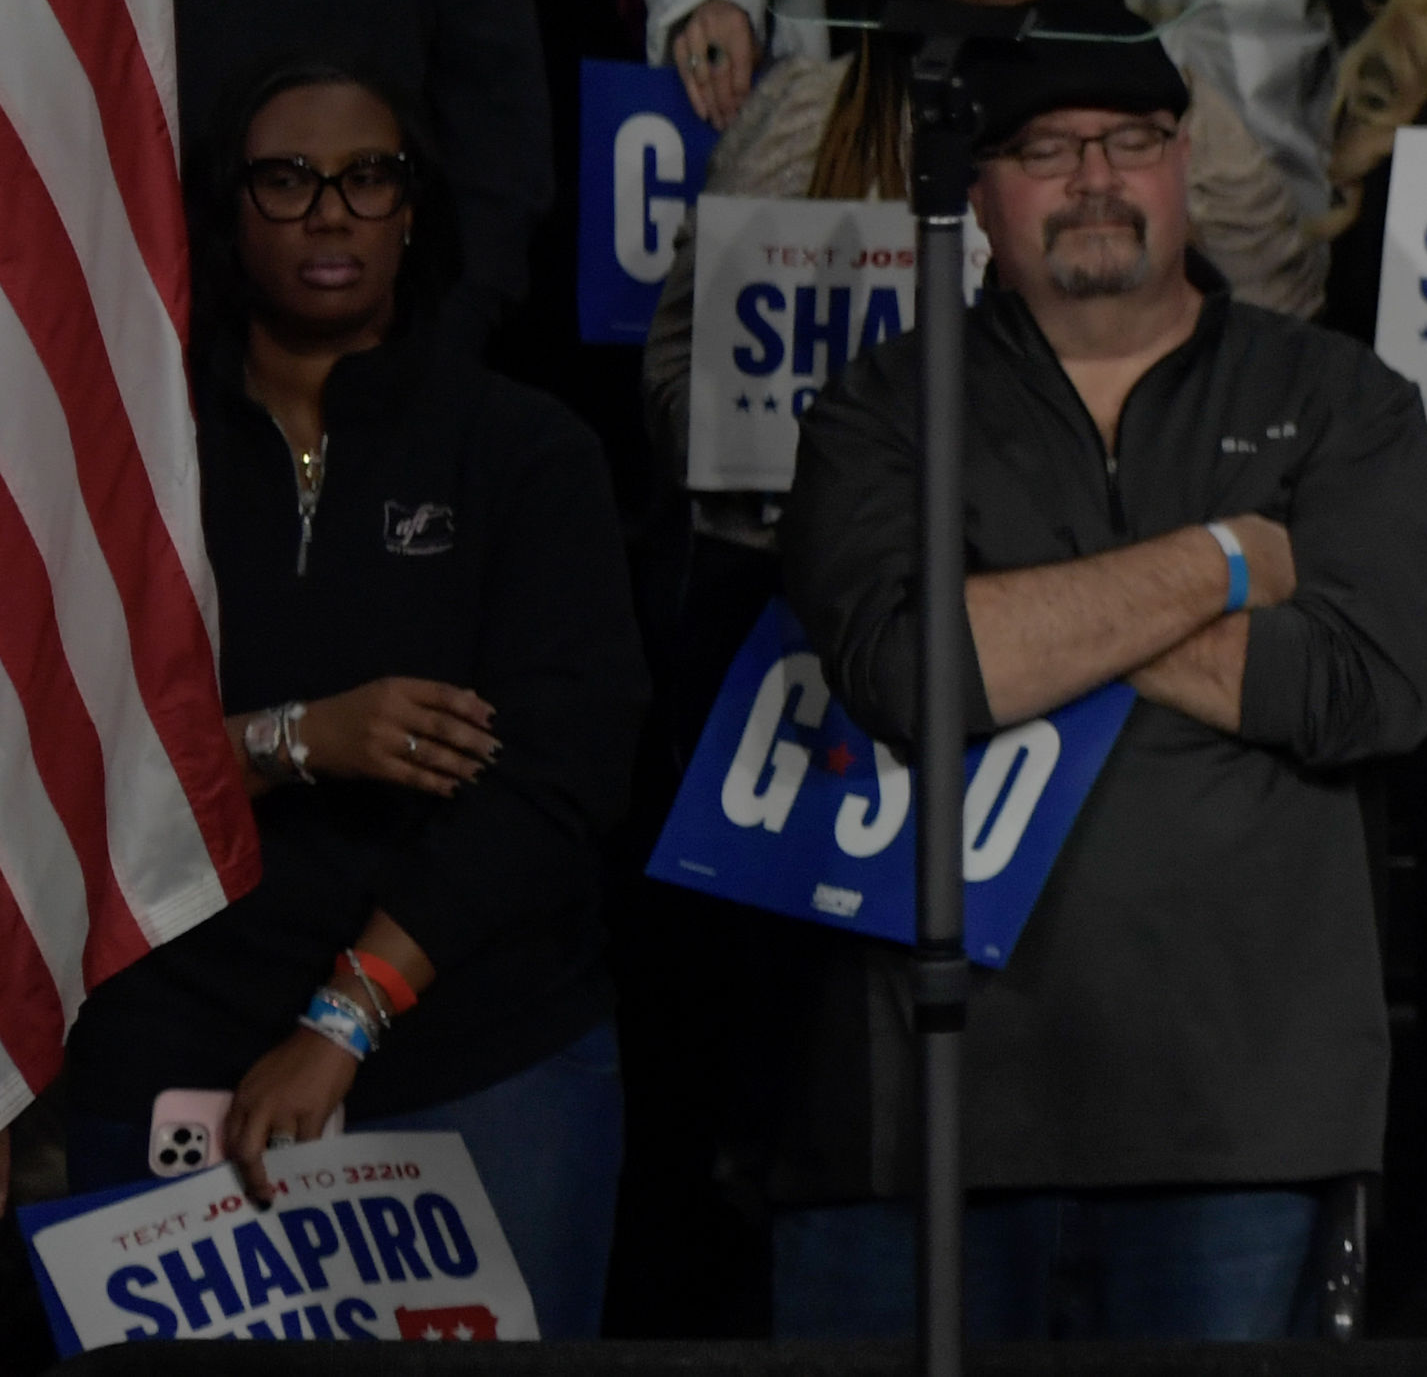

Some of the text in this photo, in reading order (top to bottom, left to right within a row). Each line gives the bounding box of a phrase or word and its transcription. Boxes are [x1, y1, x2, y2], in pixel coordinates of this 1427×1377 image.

[763, 246, 833, 269] TEXT
[850, 248, 914, 269] JOS
[113, 1163, 420, 1251] TEXT JOH TO 32210
[107, 1193, 478, 1341] SHAPIRO
